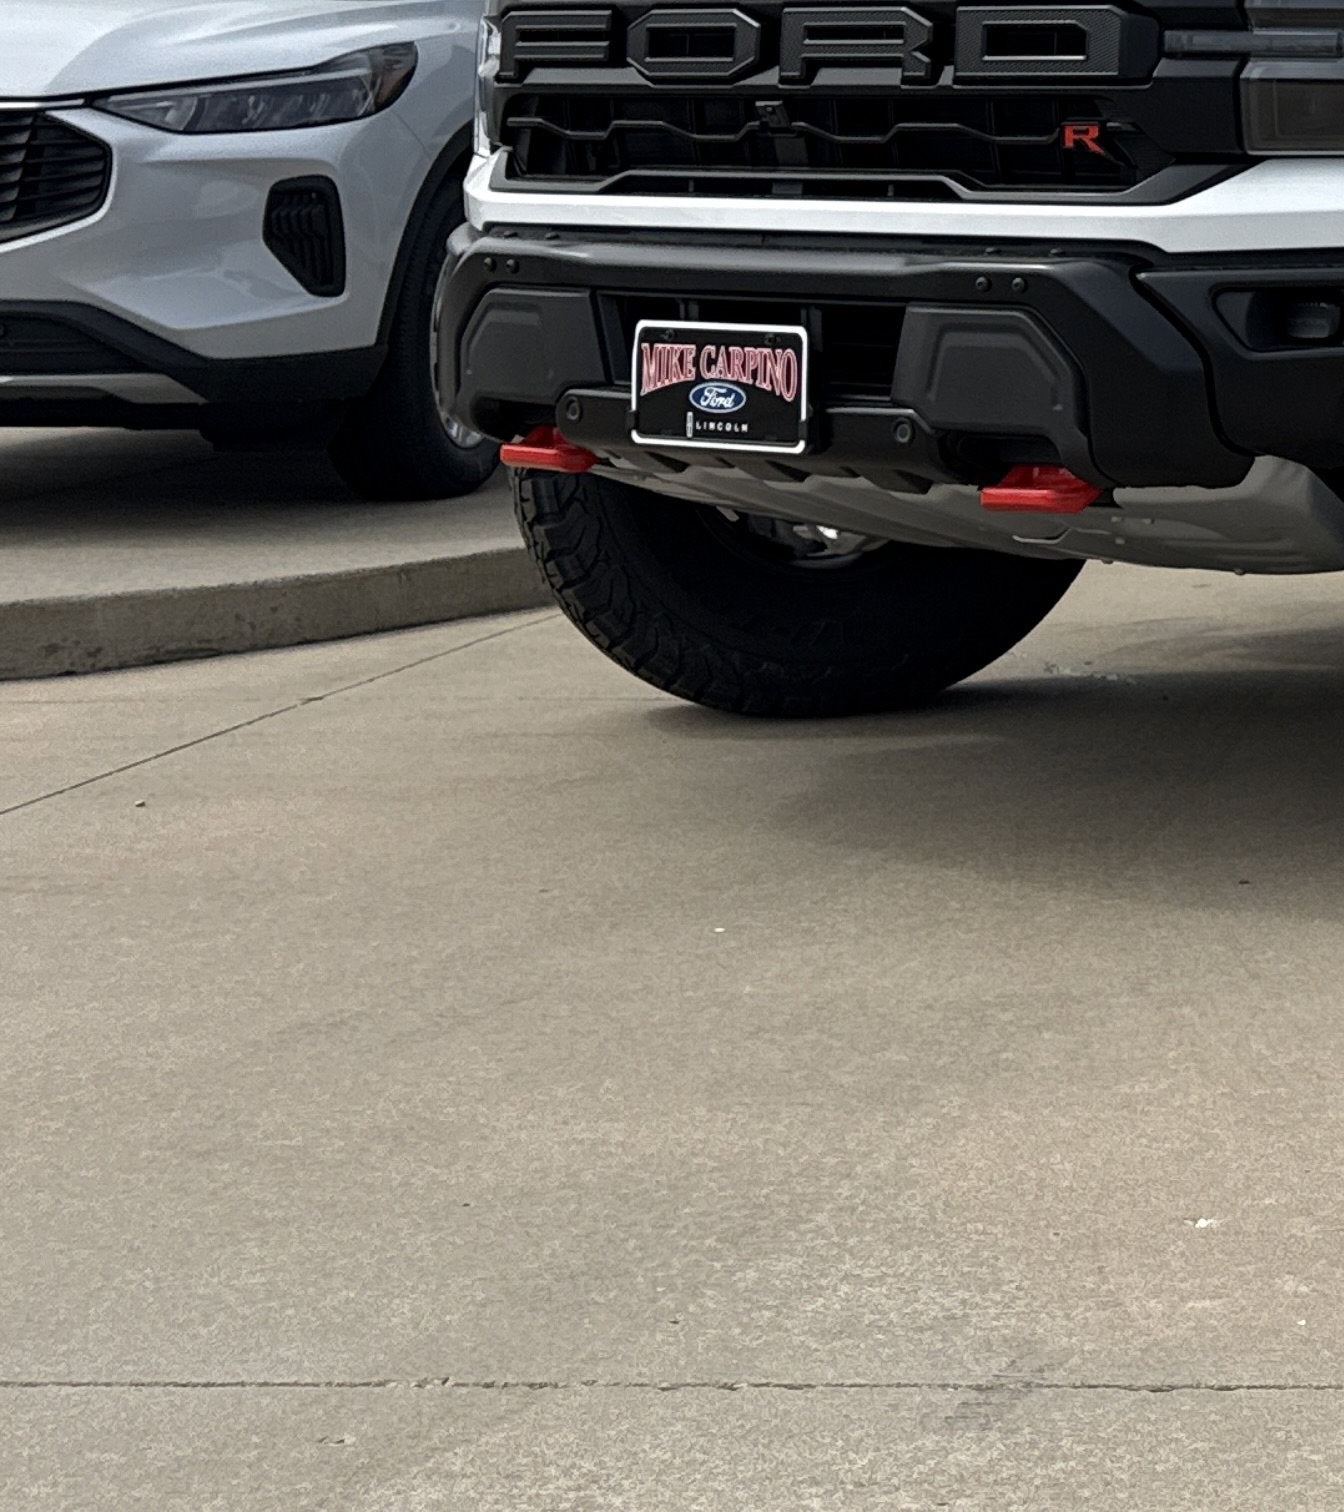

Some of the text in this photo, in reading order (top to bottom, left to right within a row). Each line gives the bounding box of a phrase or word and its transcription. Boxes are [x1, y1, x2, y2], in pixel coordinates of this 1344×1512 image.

[500, 4, 1140, 88] FORD
[1062, 121, 1105, 157] R
[640, 342, 798, 402] MIKE CARPINO
[700, 387, 737, 408] Ford
[696, 421, 748, 433] LINCOLN
